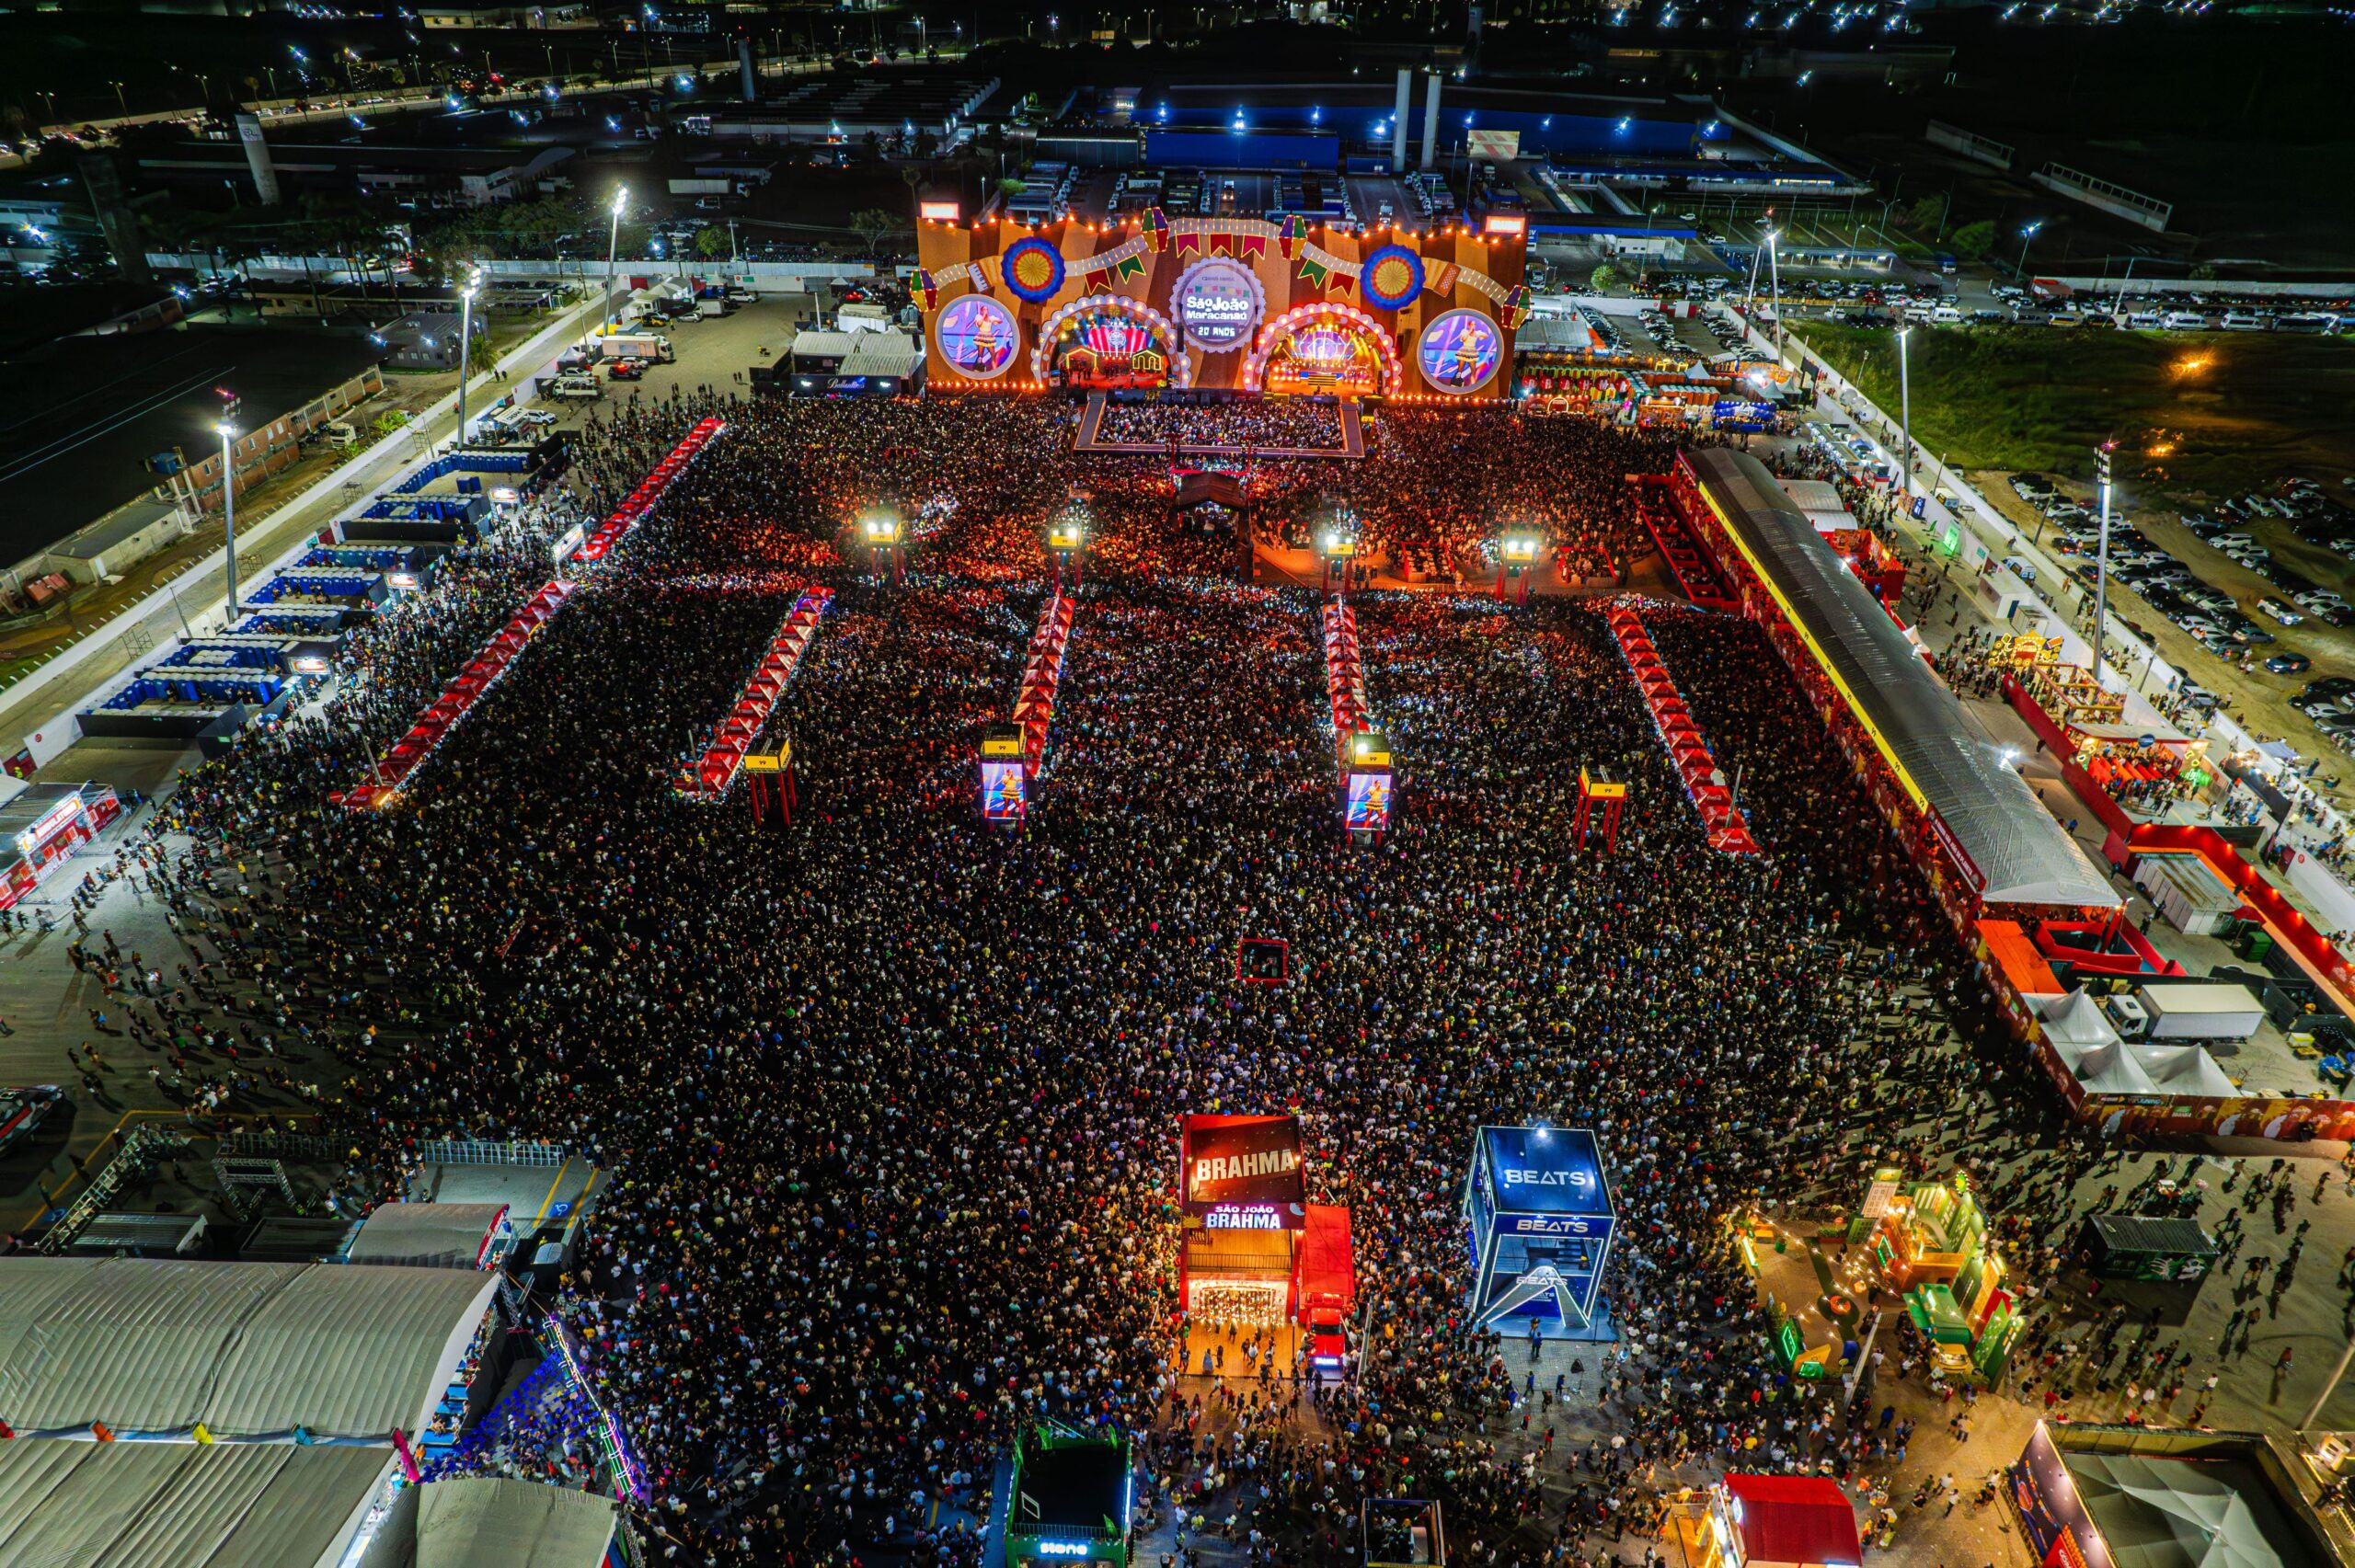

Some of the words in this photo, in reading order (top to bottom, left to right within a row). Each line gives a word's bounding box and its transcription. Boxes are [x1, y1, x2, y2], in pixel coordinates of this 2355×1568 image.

[1187, 296, 1212, 310] São
[1212, 297, 1248, 311] João
[1186, 311, 1247, 320] Maracanaú
[1198, 326, 1210, 336] 20
[1212, 326, 1235, 336] ANOS
[1197, 1149, 1296, 1182] BRAHMA
[1505, 1169, 1586, 1185] BEATS
[1215, 1204, 1239, 1213] SÃO
[1242, 1204, 1274, 1213] JOÃO
[1207, 1213, 1281, 1229] BRAHMA
[1517, 1219, 1589, 1233] BEATS
[1516, 1276, 1568, 1286] BEATS
[1040, 1543, 1087, 1555] stone
